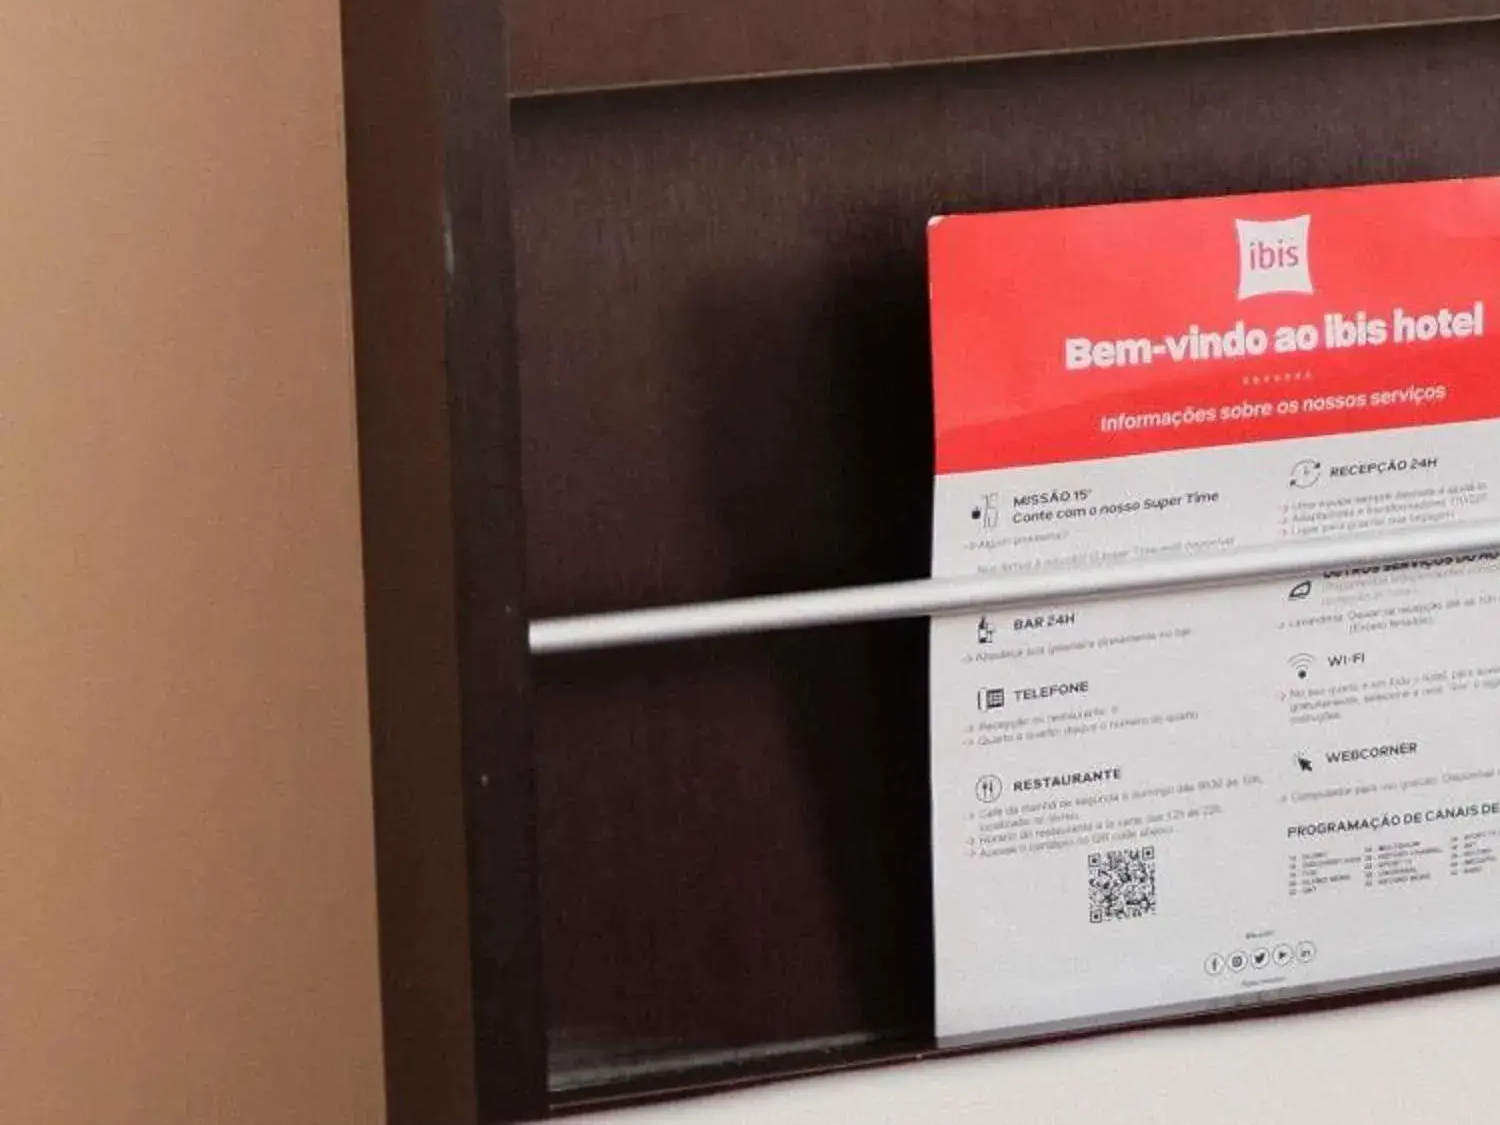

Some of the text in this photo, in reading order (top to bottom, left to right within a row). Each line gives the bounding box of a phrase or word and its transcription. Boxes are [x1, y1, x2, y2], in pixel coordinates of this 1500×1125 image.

[1249, 238, 1300, 271] ibis
[1065, 320, 1268, 370] Bem-vindo
[1274, 325, 1319, 353] ao
[1393, 300, 1484, 343] hotel
[1101, 383, 1447, 432] Informações sobre os nossos serviços
[1329, 457, 1438, 478] RECEPÇÃO 24H
[1012, 490, 1220, 524] Conte com o nosso Super Time
[1013, 489, 1071, 508] MISSÃO
[1013, 612, 1076, 632] BAR 24H
[1327, 652, 1366, 667] WI-FI
[1013, 680, 1090, 702] TELEFONE
[1325, 741, 1418, 764] WEBCORNER
[1013, 768, 1122, 792] RESTAURANTE
[1286, 814, 1401, 839] PROGRAMAÇÃO
[1403, 811, 1422, 825] DE
[1424, 804, 1479, 822] CANAIS
[1481, 801, 1500, 815] DE
